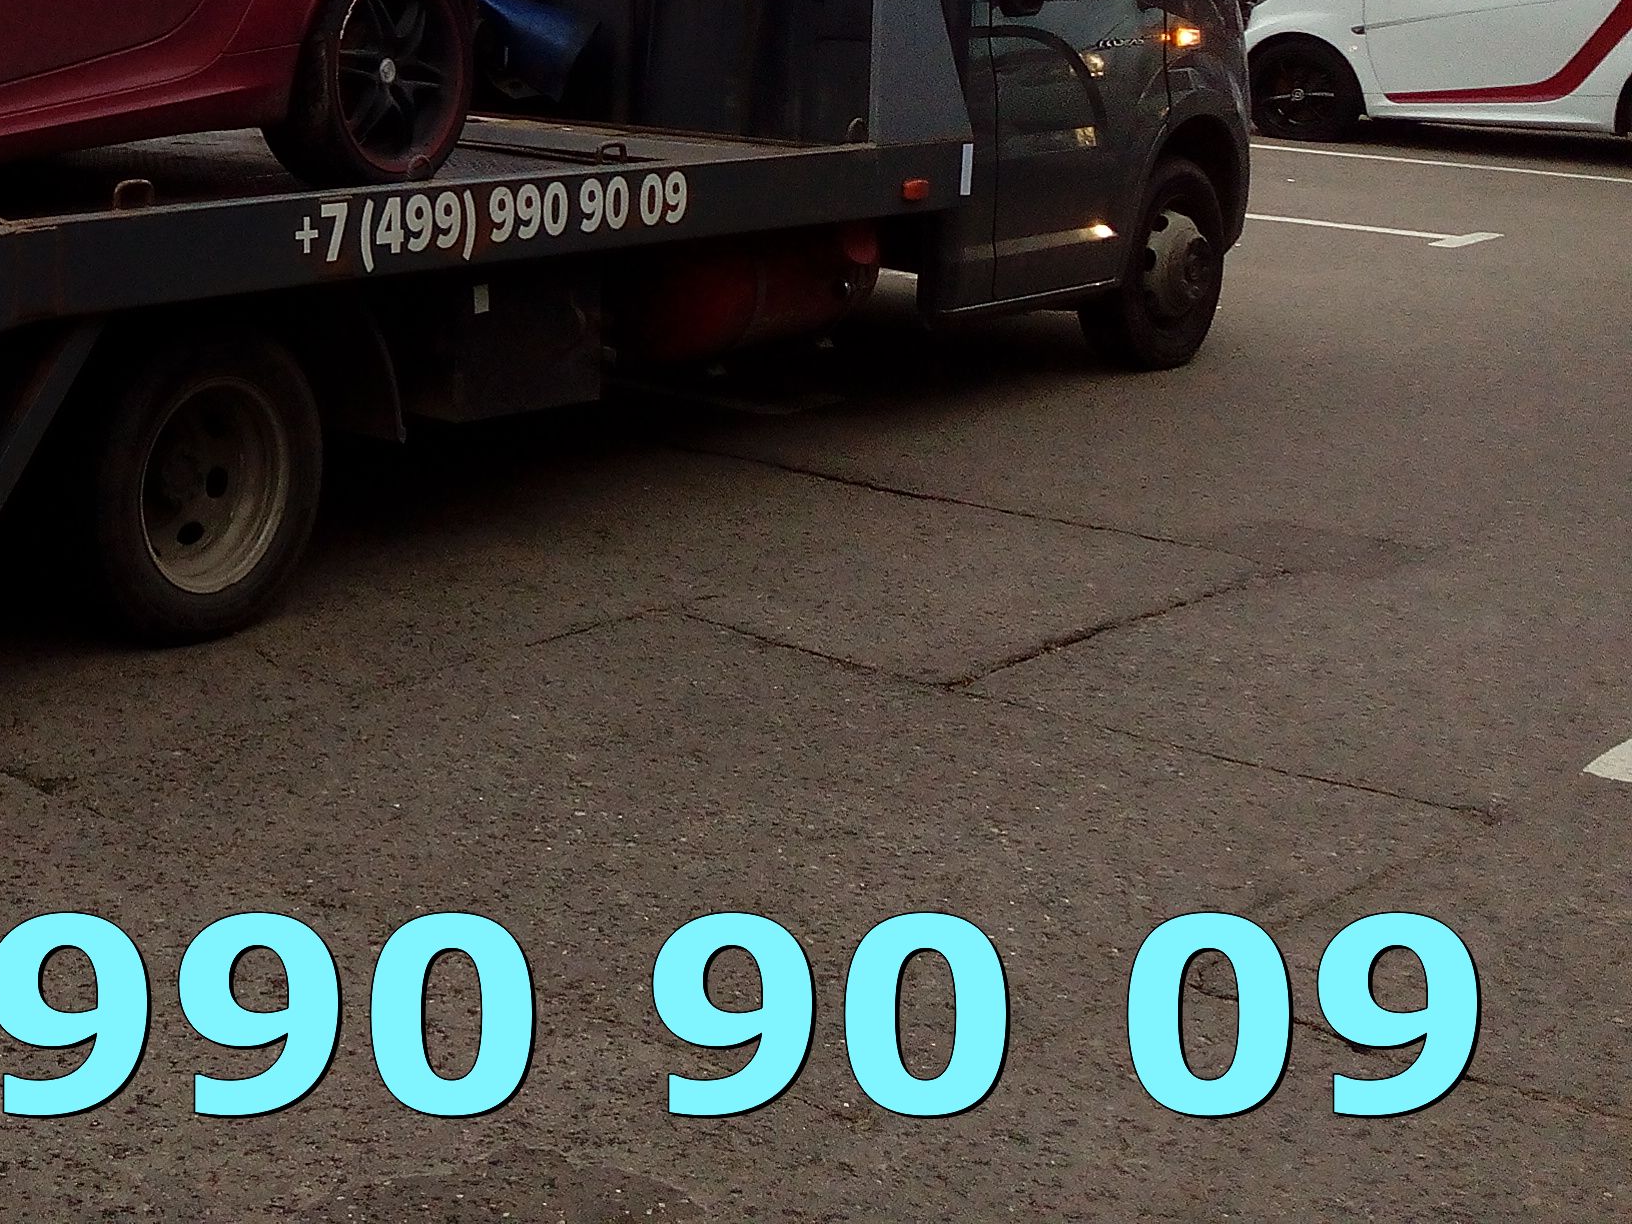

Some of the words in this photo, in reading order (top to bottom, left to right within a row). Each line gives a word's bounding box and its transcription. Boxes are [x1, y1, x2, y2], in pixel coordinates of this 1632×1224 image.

[295, 201, 348, 262] +7
[360, 189, 476, 273] (499)
[489, 181, 568, 243] 990
[579, 176, 629, 233] 90
[639, 171, 687, 224] 09
